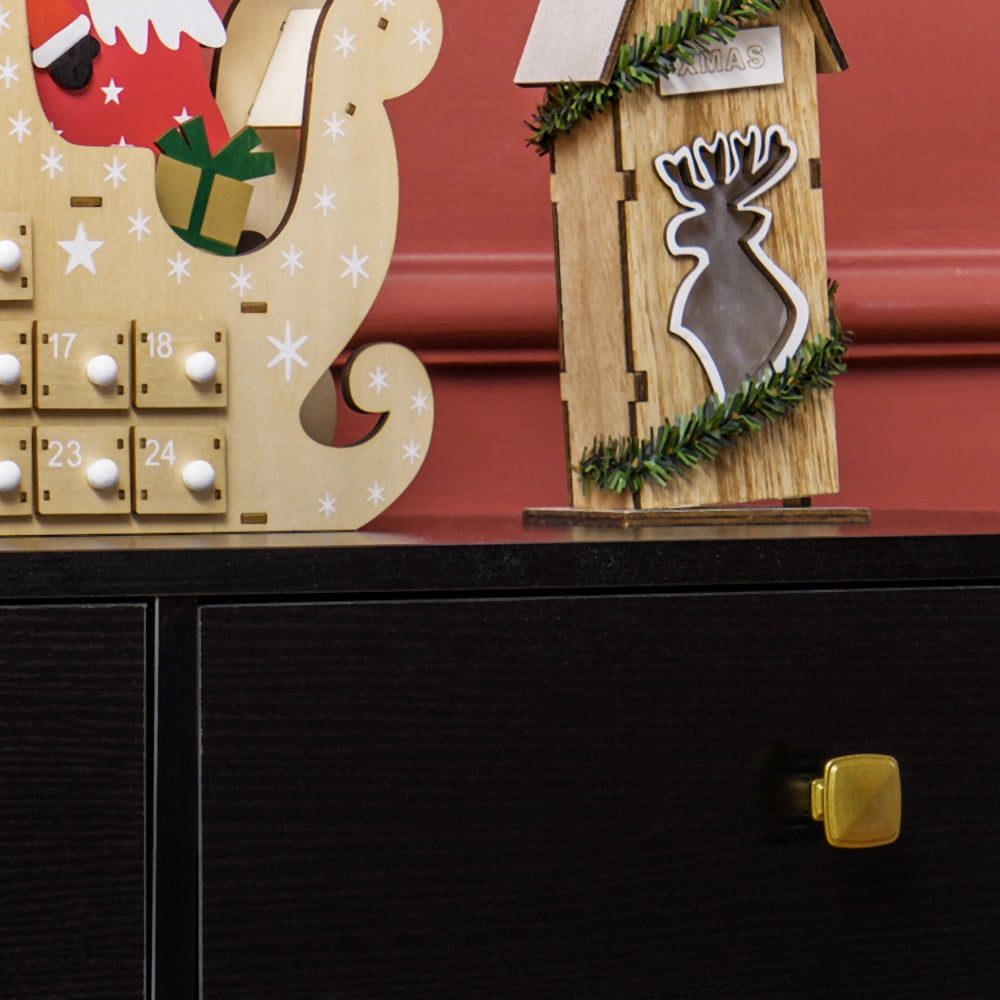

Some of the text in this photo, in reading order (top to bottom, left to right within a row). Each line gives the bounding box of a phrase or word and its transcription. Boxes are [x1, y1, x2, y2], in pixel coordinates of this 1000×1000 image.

[48, 331, 79, 359] 17
[146, 330, 175, 359] 18
[49, 439, 84, 468] 23
[145, 439, 178, 467] 24
